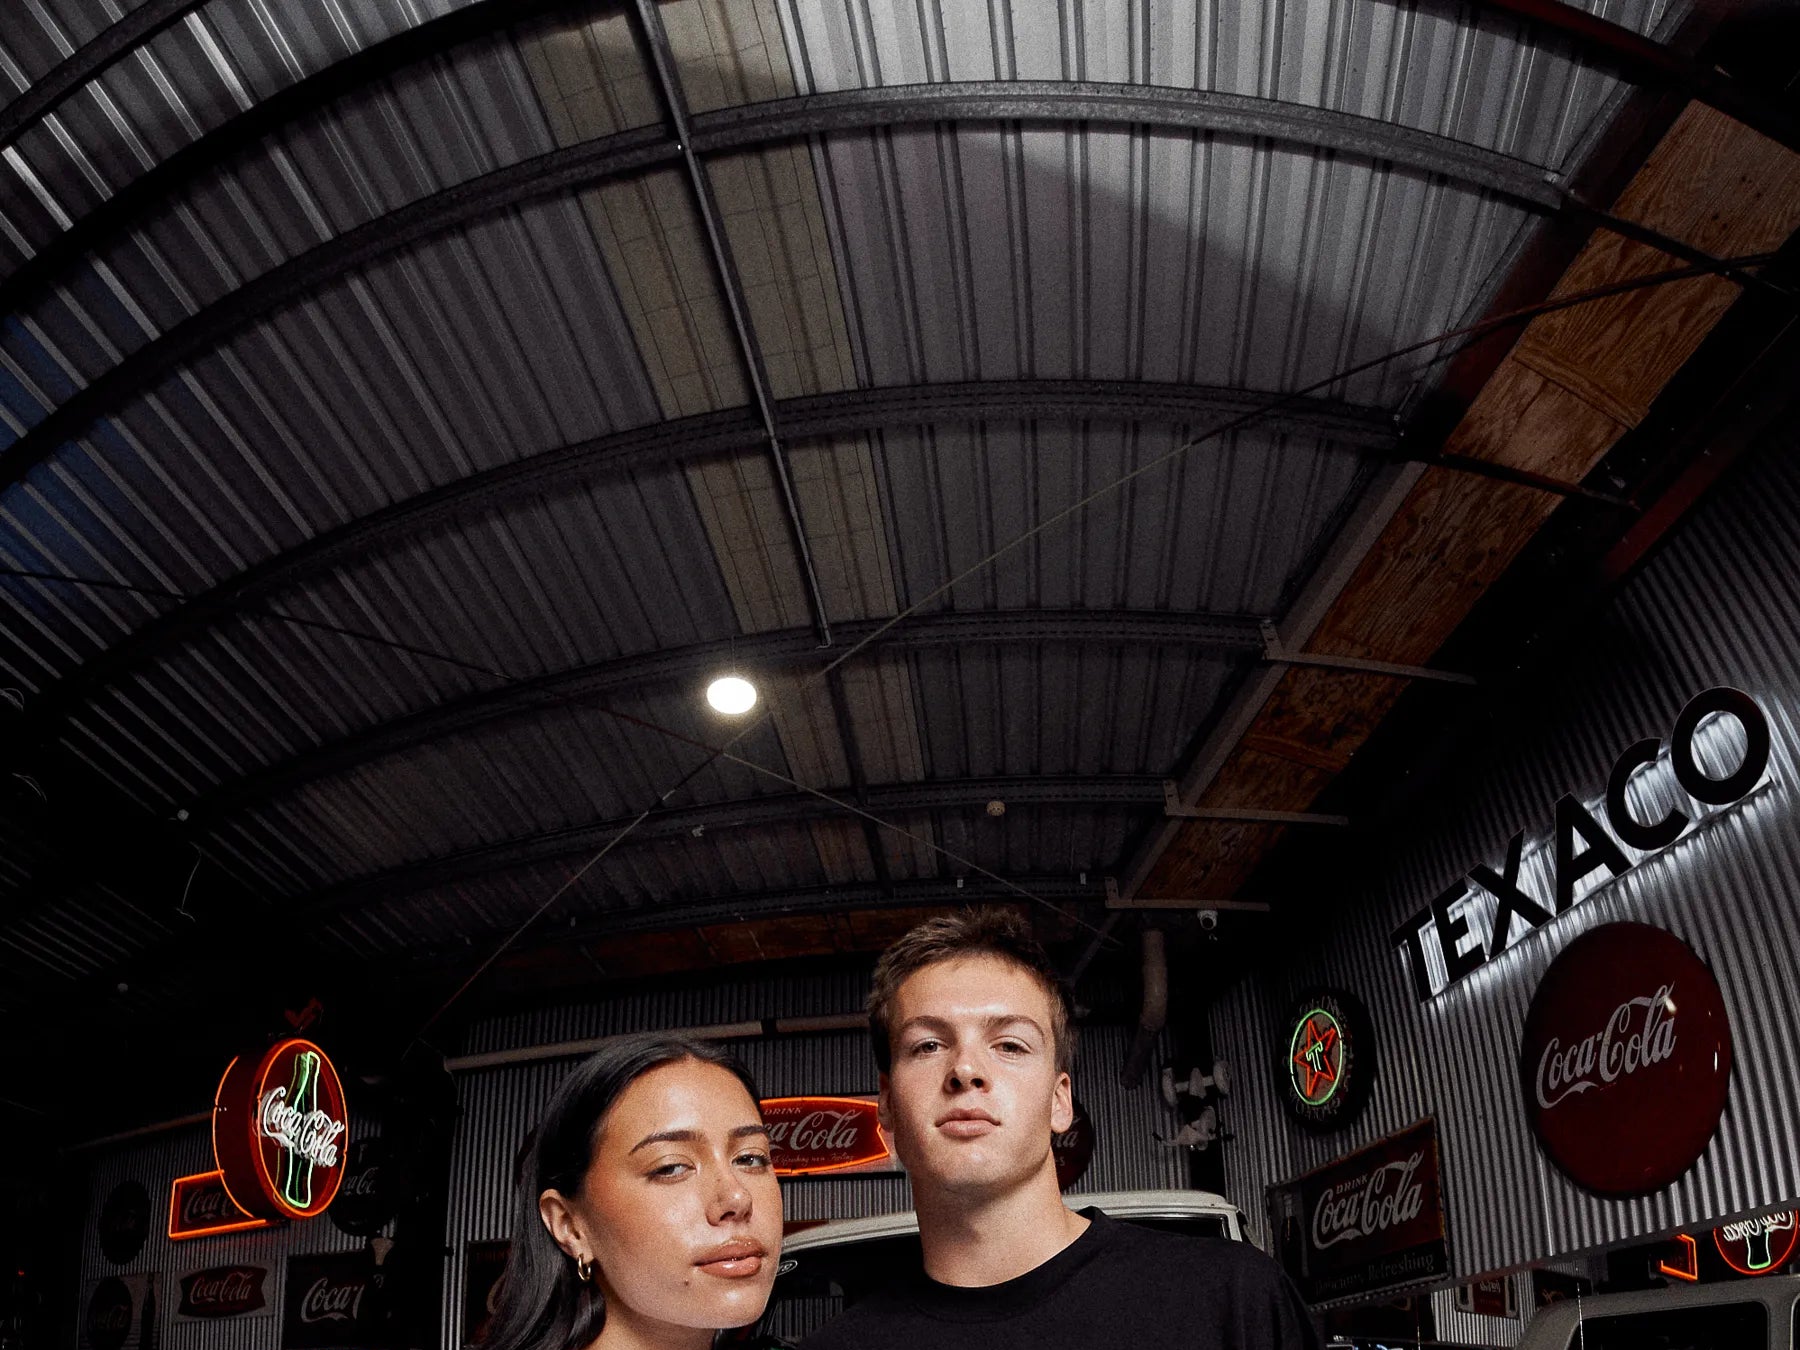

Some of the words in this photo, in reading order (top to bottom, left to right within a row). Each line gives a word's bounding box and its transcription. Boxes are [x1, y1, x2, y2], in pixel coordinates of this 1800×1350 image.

[1391, 686, 1771, 1004] TEXACO
[1536, 980, 1677, 1109] Coca-Cola
[763, 1106, 803, 1116] DRINK
[764, 1109, 863, 1151] a-Cola
[1312, 1149, 1424, 1250] Coca-Cola
[1336, 1173, 1368, 1195] DRINK
[189, 1271, 255, 1304] Coca-Cola
